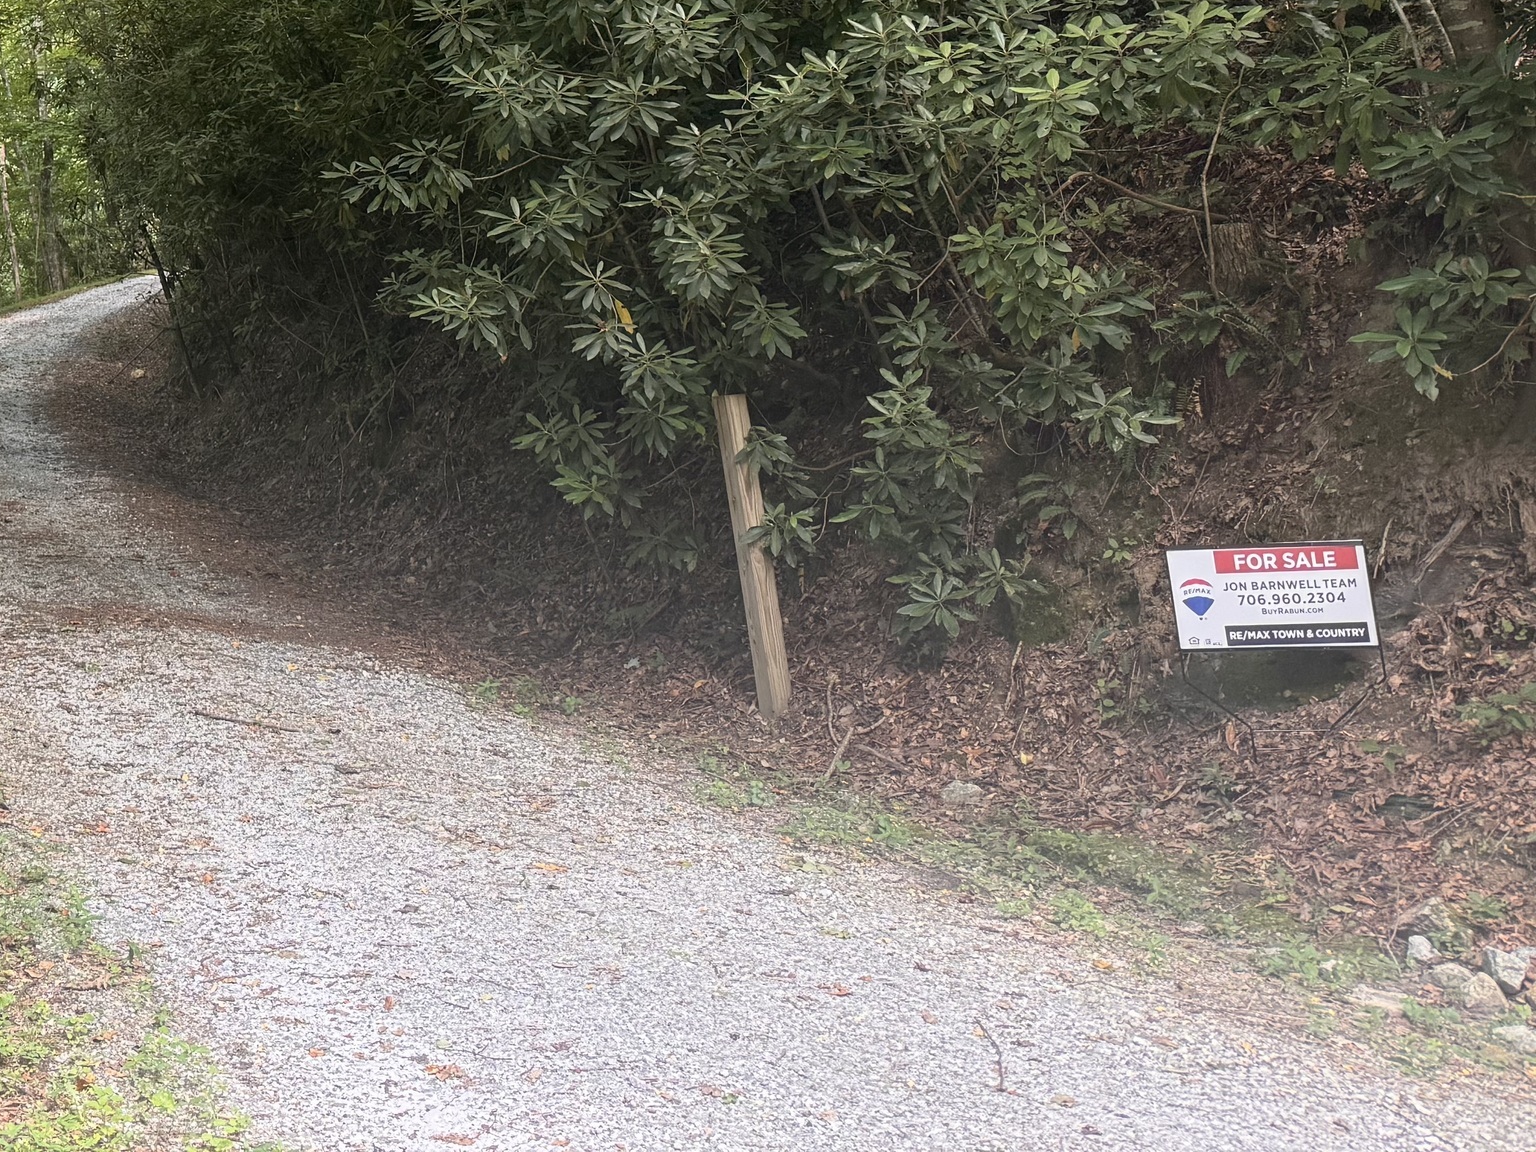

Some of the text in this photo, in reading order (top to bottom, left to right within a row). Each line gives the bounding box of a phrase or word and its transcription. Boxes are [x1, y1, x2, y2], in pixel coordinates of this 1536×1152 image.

[1233, 551, 1337, 570] FOR SALE
[1183, 588, 1211, 596] RE/MAX
[1223, 578, 1357, 592] JON BARNWELL TEAM
[1237, 592, 1346, 606] 706.960.2304
[1229, 628, 1366, 640] RE/MAX TOWN & COUNTRY
